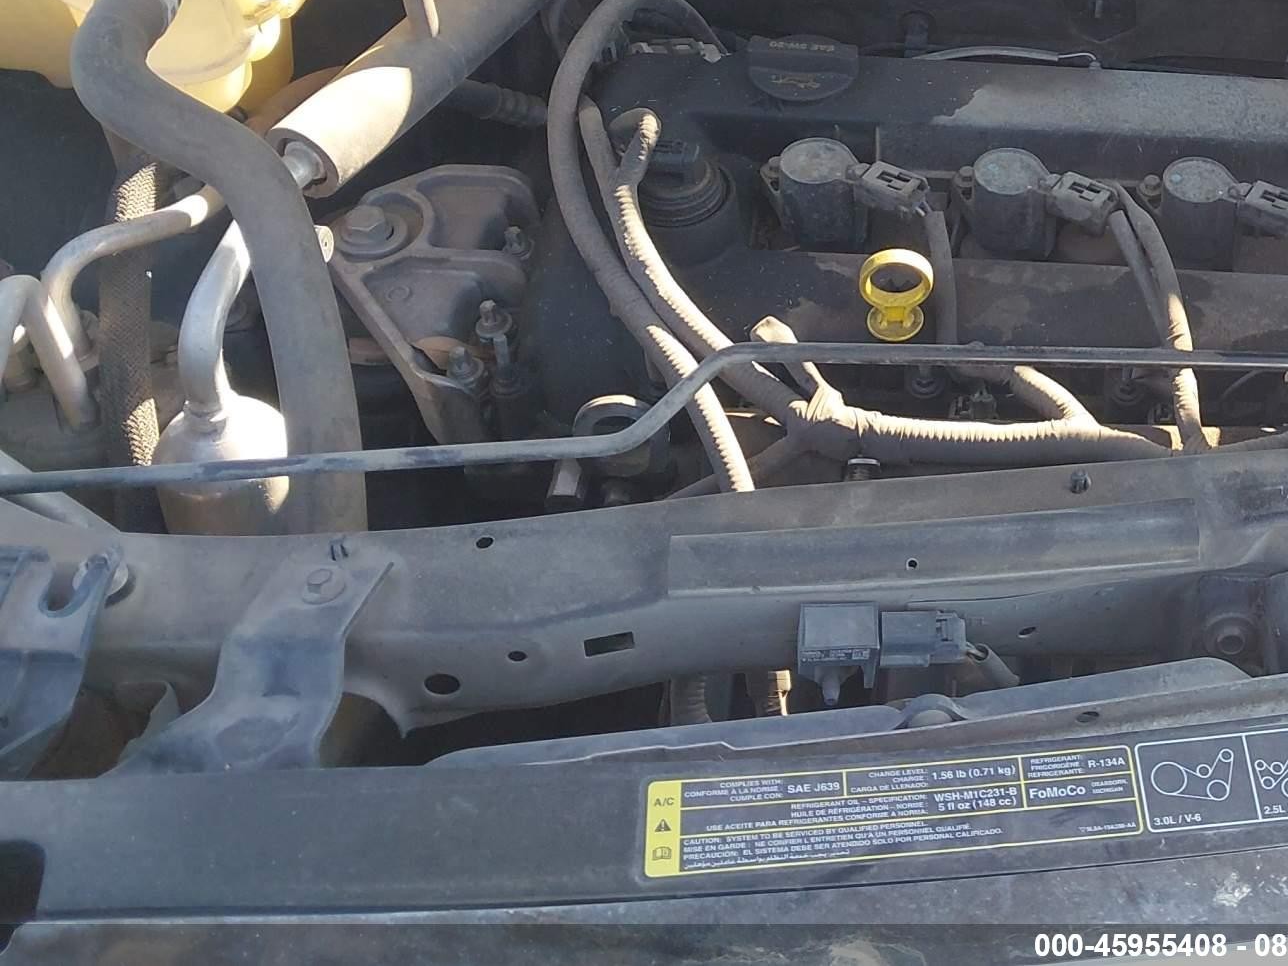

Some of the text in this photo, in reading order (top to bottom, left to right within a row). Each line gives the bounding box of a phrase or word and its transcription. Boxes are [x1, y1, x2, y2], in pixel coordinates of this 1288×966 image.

[1087, 757, 1126, 767] R-134A
[932, 765, 1016, 779] 1.56 lb (0.71 kg)
[684, 789, 728, 798] CONFORME
[787, 781, 840, 793] SAE J639
[934, 787, 1017, 801] WSH-M1C231-B
[1028, 784, 1086, 798] FoMoCo
[654, 797, 675, 807] A/C
[790, 800, 845, 809] REFRIGERANT
[937, 803, 944, 811] 5
[947, 802, 955, 810] fl
[972, 798, 996, 808] (148
[998, 796, 1016, 806] cc)
[1263, 805, 1286, 814] 2.5L
[778, 814, 843, 825] REFRIGERANTES
[844, 811, 888, 820] CONFORME
[1154, 815, 1177, 826] 3.0L
[1184, 813, 1201, 822] V-6
[683, 837, 721, 845] CAUTION:
[726, 834, 758, 842] SYSTEM
[785, 829, 824, 837] SERVICED
[837, 824, 878, 833] QUALIFIED
[718, 842, 745, 850] GARDE
[767, 837, 802, 846] CONFIER
[888, 827, 934, 836] PERSONNEL
[755, 846, 788, 854] SISTEMA
[913, 832, 954, 841] PERSONAL
